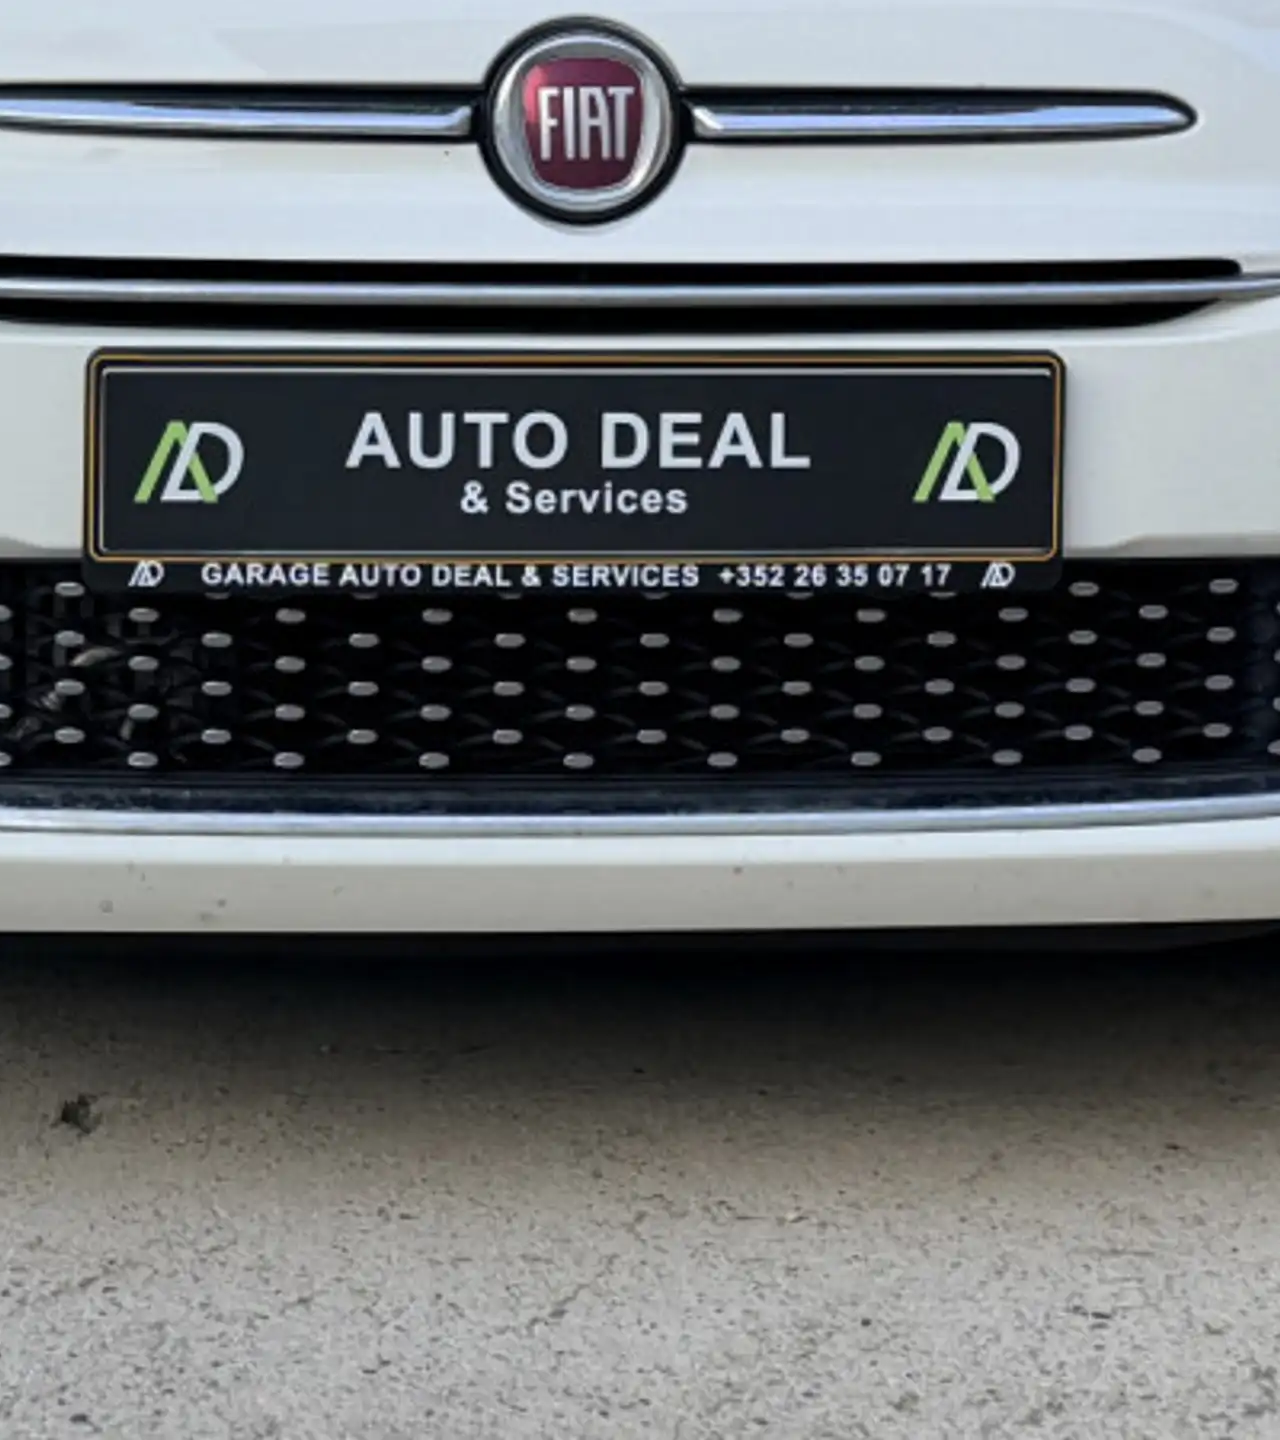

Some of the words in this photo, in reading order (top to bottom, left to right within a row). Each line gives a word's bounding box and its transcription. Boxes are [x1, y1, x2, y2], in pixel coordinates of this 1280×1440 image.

[537, 86, 635, 160] FIAT
[345, 410, 569, 469] AUTO
[601, 412, 811, 469] DEAL
[460, 481, 489, 514] &
[505, 481, 688, 515] Services
[201, 563, 330, 586] GARAGE
[339, 563, 421, 587] AUTO
[432, 563, 512, 587] DEAL
[521, 563, 542, 587] &
[552, 563, 700, 588] SERVICES
[717, 563, 785, 588] +352
[794, 563, 827, 588] 26
[836, 563, 869, 588] 35
[878, 563, 910, 588] 07
[922, 563, 952, 588] 17
